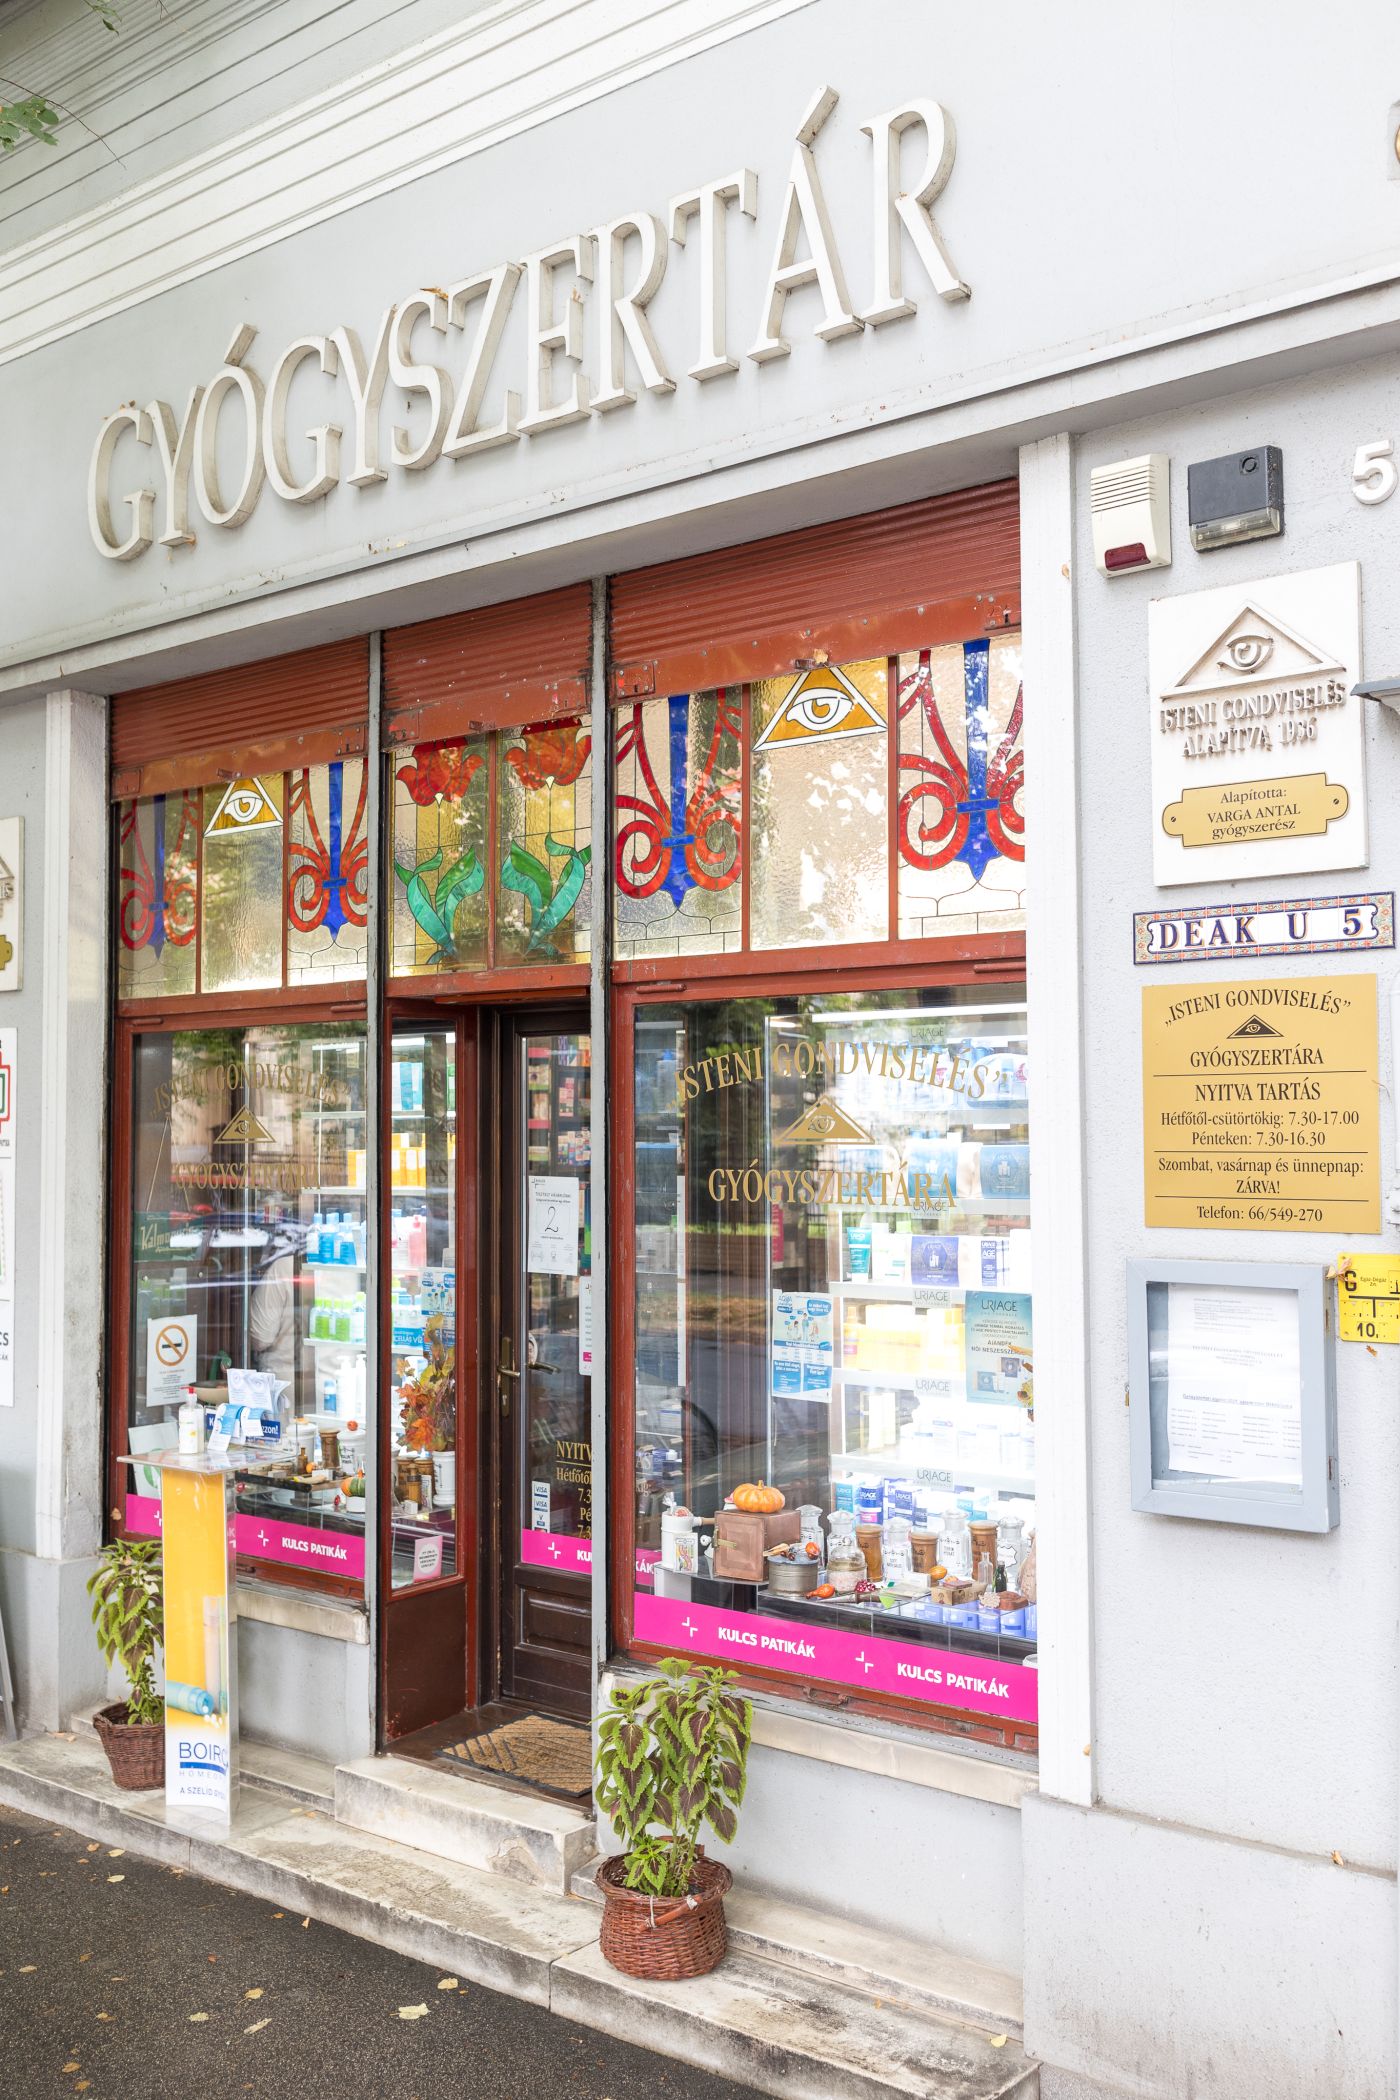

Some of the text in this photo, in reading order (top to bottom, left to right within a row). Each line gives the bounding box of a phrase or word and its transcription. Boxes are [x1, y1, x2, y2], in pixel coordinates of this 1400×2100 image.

[87, 85, 971, 562] GYÓGYSZERTÁR
[1353, 439, 1398, 505] 5
[1160, 680, 1347, 733] ISTENI GONDVISELÉS
[1182, 717, 1318, 758] ALAPÍTVA 1936
[1220, 787, 1287, 805] Alapította:
[1207, 803, 1301, 824] VARGA ANTAL
[1212, 818, 1296, 840] gyógyszerész
[1158, 908, 1364, 950] DEAK U 5
[1190, 1044, 1324, 1068] GYÓGYSZERTÁRA
[1195, 1077, 1321, 1101] NYITVA TARTÁS
[1161, 1110, 1359, 1128] Hétfőtől-csütörtökig: 7.30-17.00
[1192, 1131, 1326, 1146] Pénteken: 7.30-16.30
[1158, 1157, 1364, 1178] Szombat, vasárnap és ünnepnap:
[708, 1159, 957, 1208] GYÓGYSZERTÁRA
[1236, 1178, 1281, 1194] ZÁRVA!
[544, 1206, 559, 1233] 2
[1197, 1206, 1323, 1222] Telefon: 66/549-270
[914, 1290, 949, 1302] URIAGE
[981, 1299, 1018, 1313] URIAGE
[556, 1440, 592, 1461] NYITV
[916, 1469, 952, 1482] URIAGE
[282, 1537, 348, 1560] KULCS PATIKÁK
[718, 1626, 816, 1659] KULCS PATIKÁK
[897, 1662, 1010, 1699] KULCS PATIKÁK
